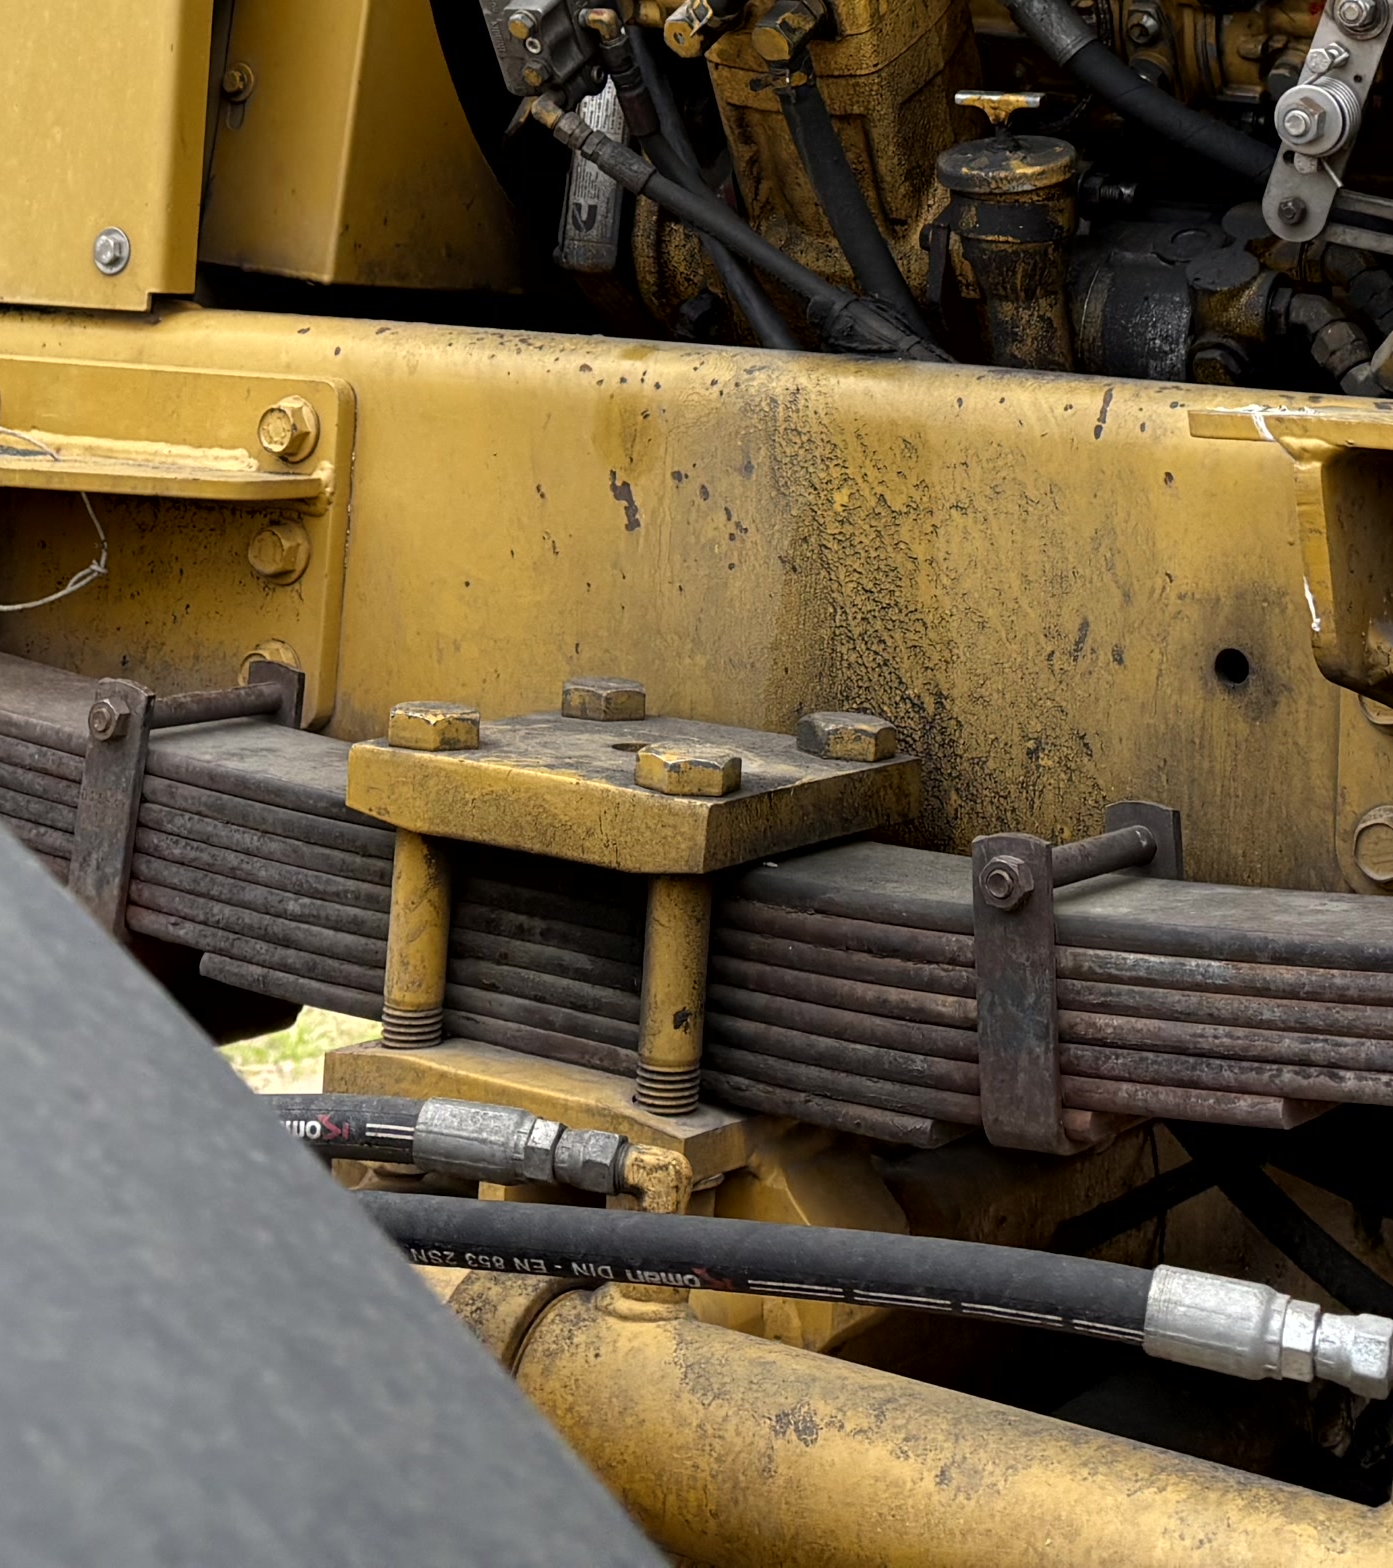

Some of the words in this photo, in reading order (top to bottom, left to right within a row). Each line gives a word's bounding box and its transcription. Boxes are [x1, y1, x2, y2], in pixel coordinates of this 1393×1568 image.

[409, 1247, 458, 1265] 2SN
[463, 1251, 506, 1270] 853
[512, 1256, 548, 1273] EN
[569, 1261, 615, 1279] DIN
